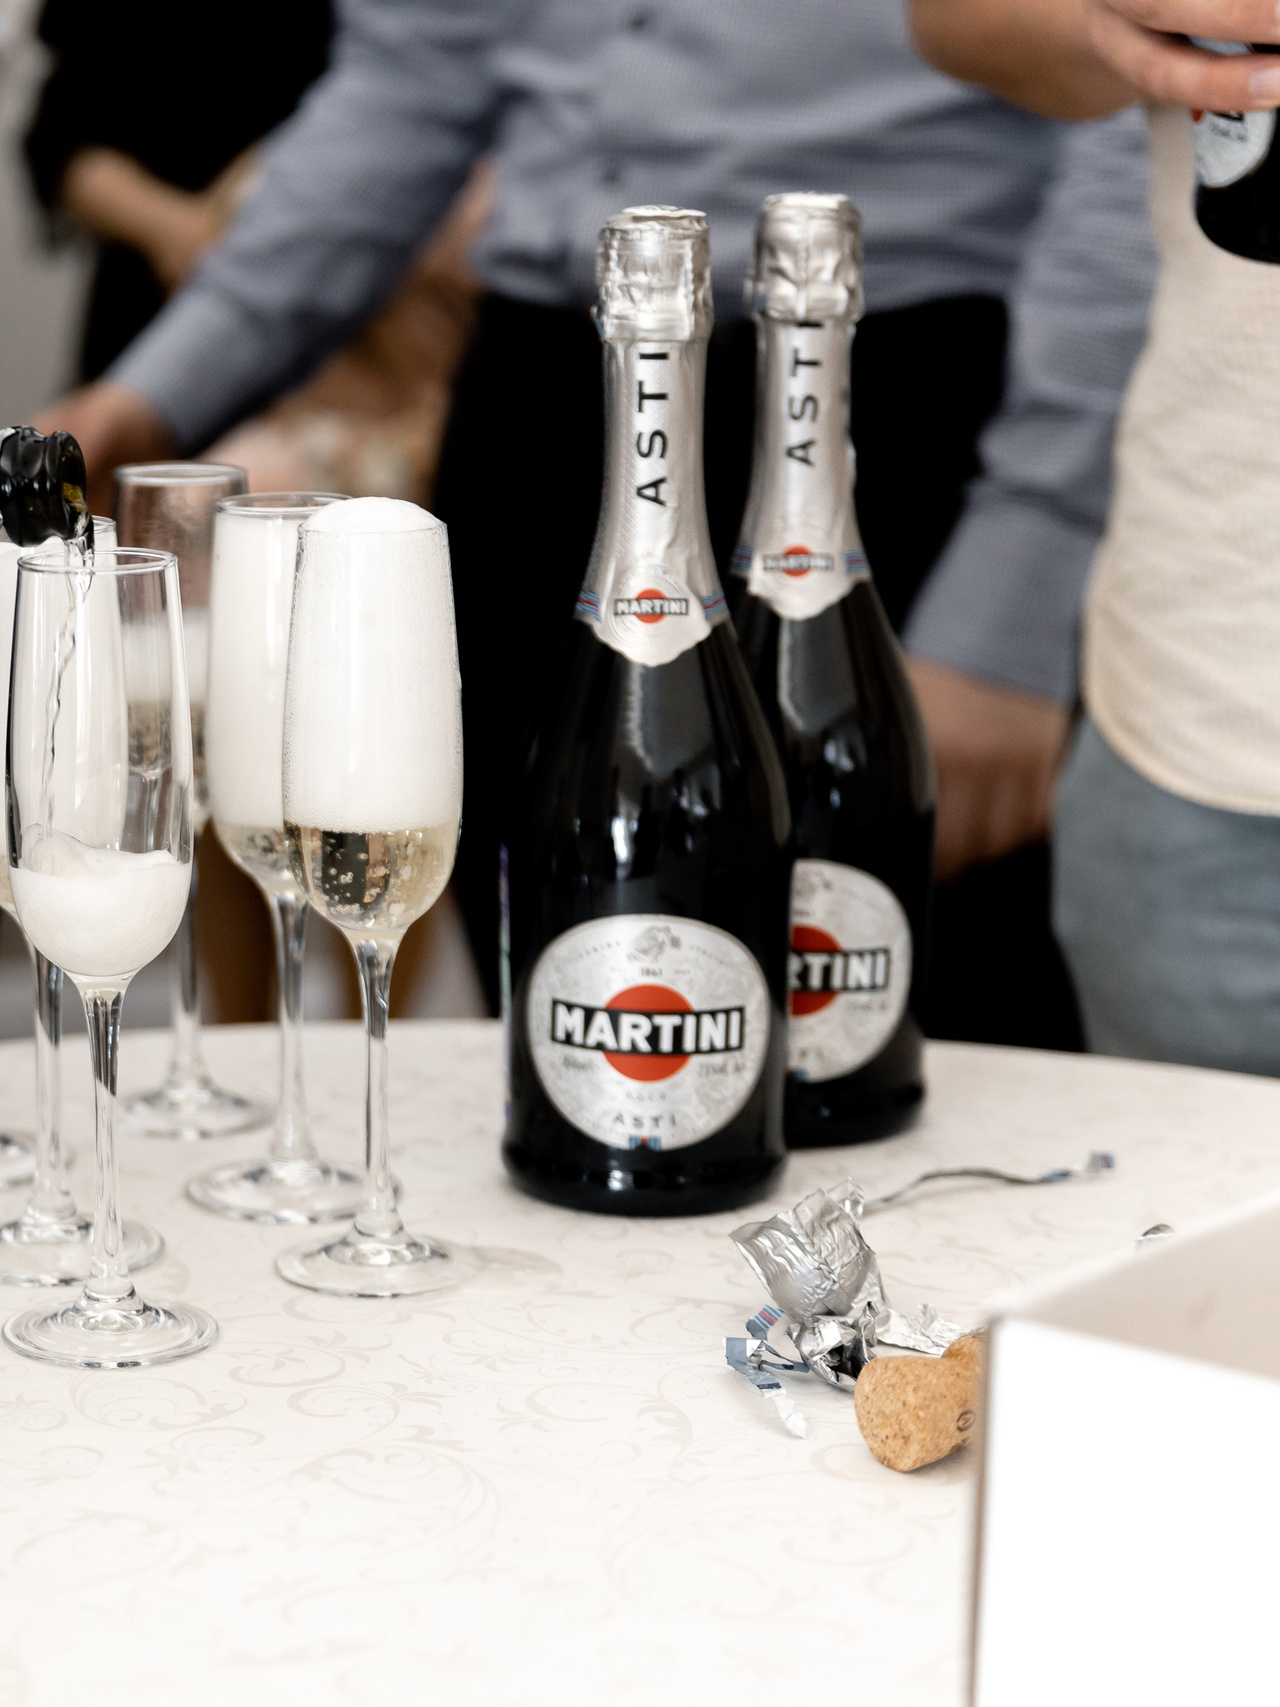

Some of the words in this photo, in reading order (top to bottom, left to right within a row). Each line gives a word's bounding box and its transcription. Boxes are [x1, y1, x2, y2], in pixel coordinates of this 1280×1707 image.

[785, 319, 824, 467] ASTI
[636, 351, 669, 507] ASTI
[616, 599, 687, 614] MARTINI
[789, 952, 886, 990] RTINI
[554, 1003, 743, 1053] MARTINI
[613, 1112, 678, 1129] ASTI
